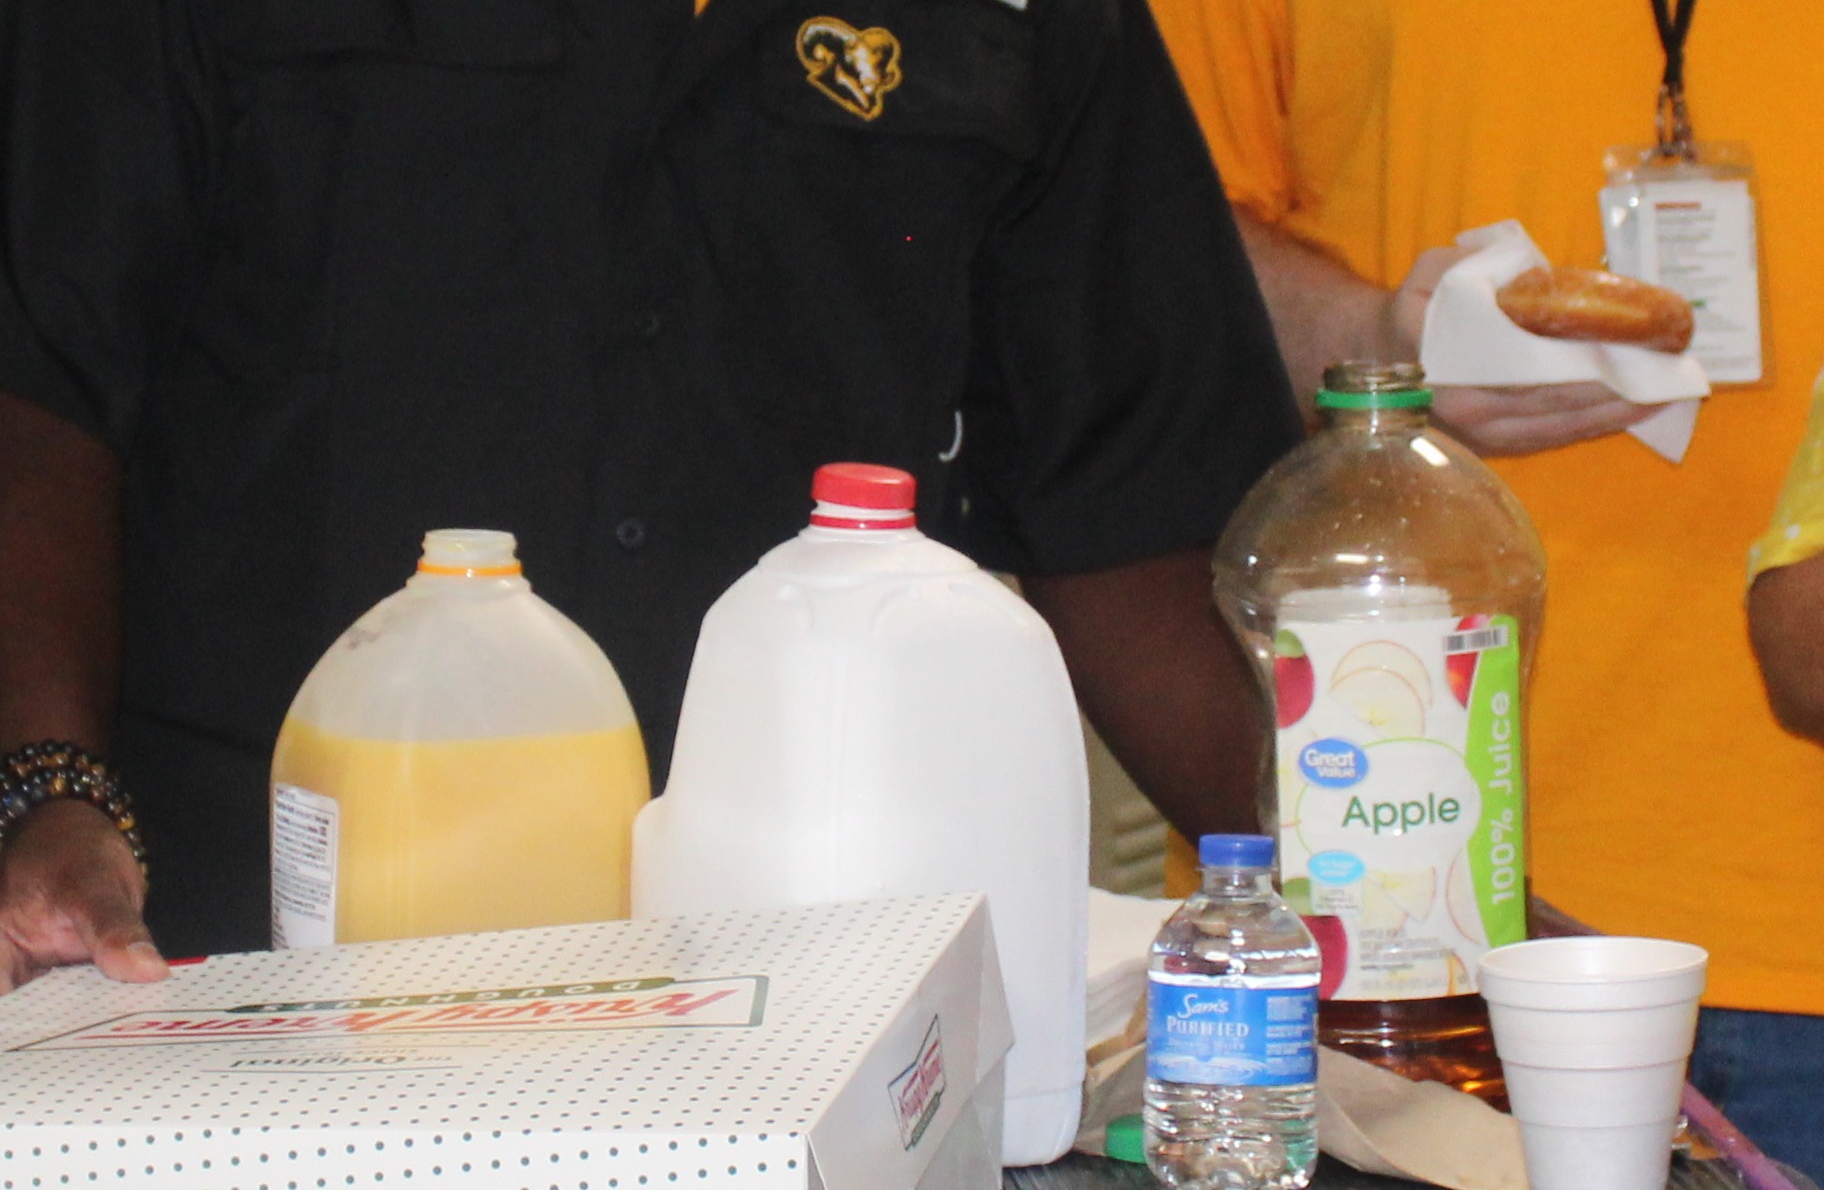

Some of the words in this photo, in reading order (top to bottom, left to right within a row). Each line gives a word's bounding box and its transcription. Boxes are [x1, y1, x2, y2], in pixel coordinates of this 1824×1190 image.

[1305, 748, 1356, 768] Great
[1487, 691, 1513, 796] Juice
[1318, 765, 1357, 779] Value
[1341, 791, 1461, 835] Apple
[1489, 807, 1516, 905] 100%
[259, 980, 642, 1013] DOUGHNUTS
[385, 988, 739, 1030] Krispy
[1177, 992, 1230, 1019] Sam's
[80, 1005, 415, 1039] Kreme
[1166, 1014, 1250, 1038] PURIFIED
[229, 1053, 407, 1068] Original
